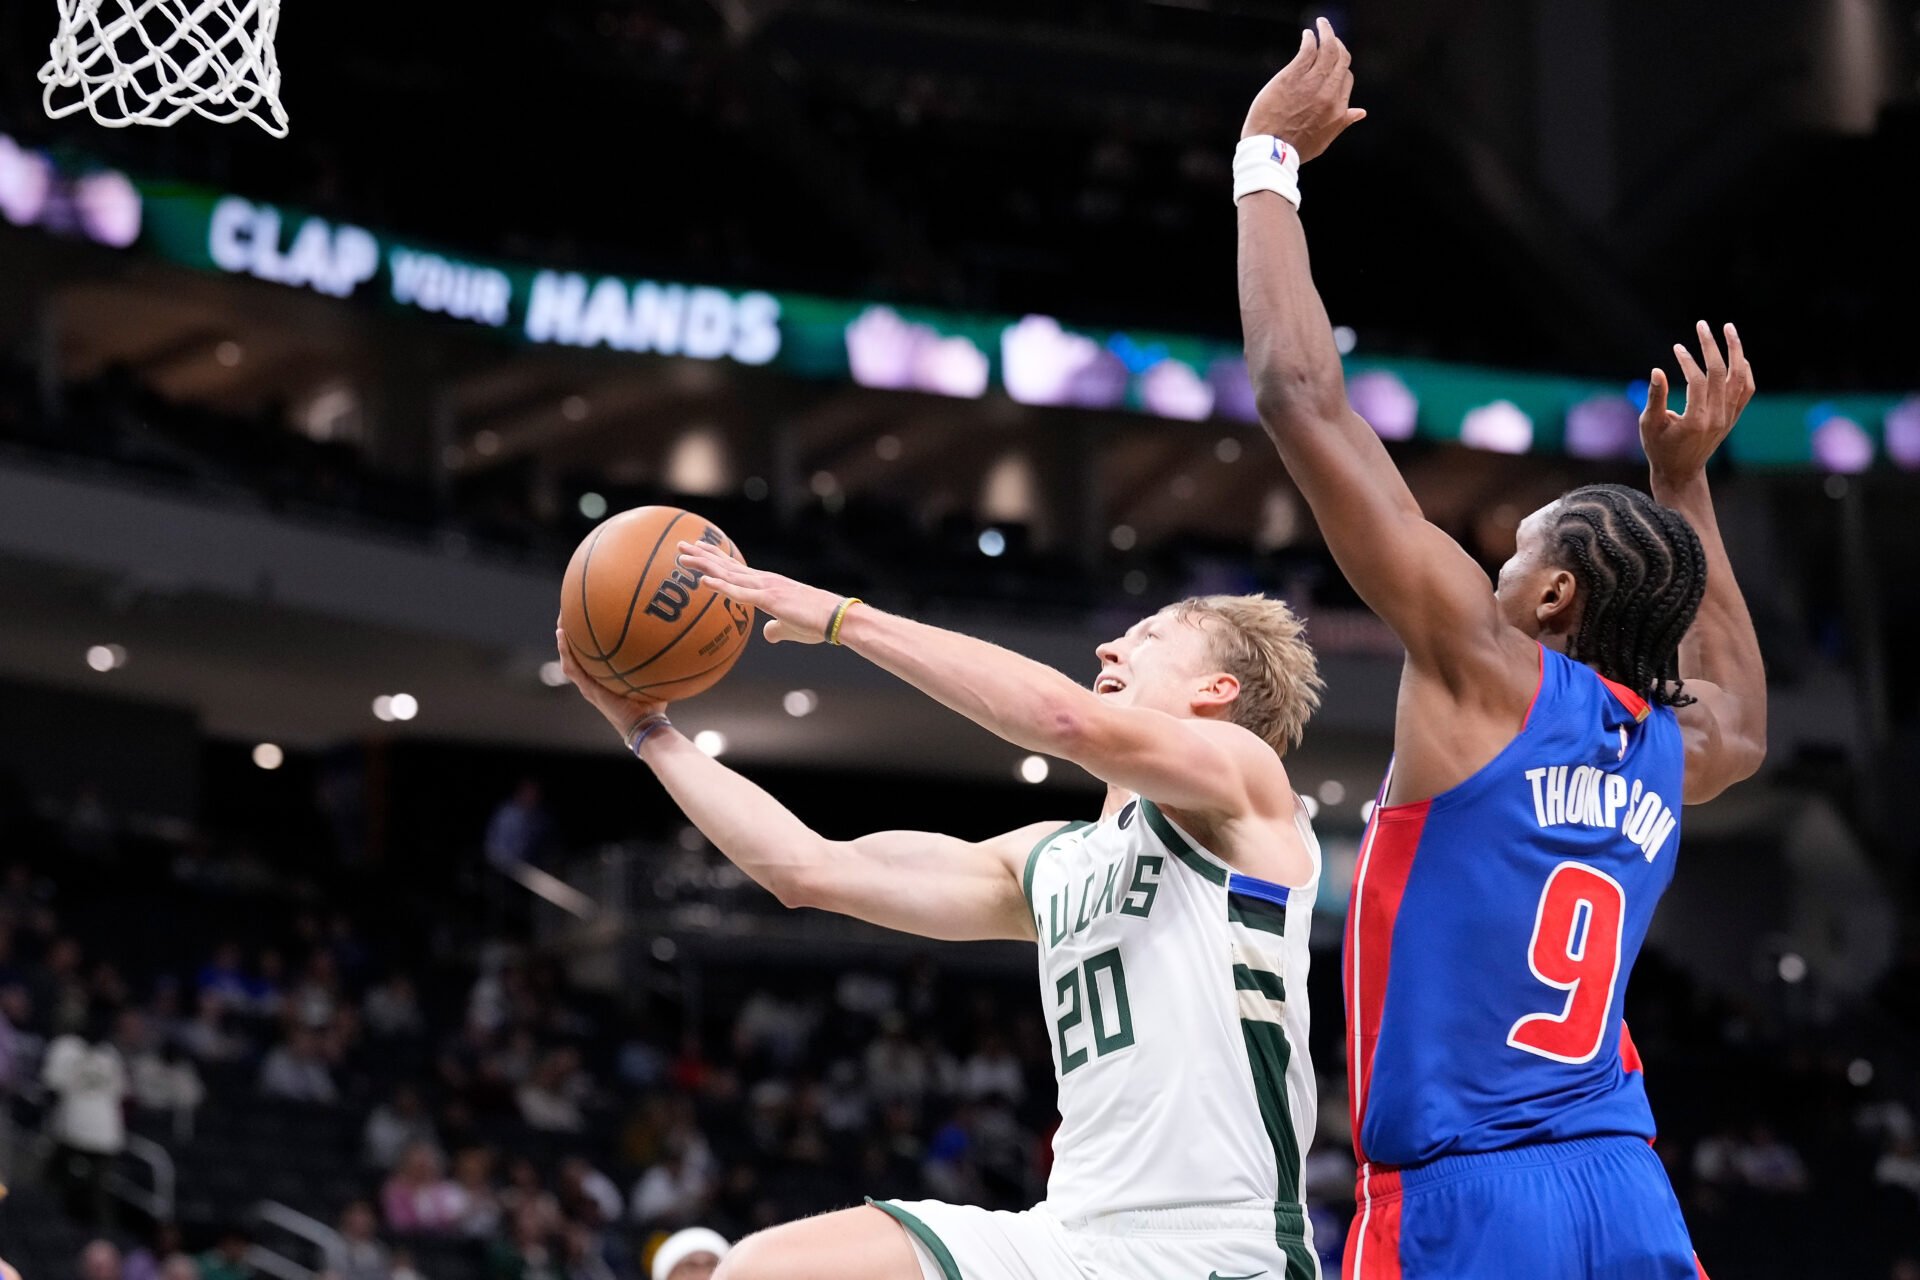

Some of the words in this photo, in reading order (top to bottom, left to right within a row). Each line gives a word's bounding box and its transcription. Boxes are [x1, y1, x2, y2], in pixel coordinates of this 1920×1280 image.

[208, 195, 379, 298] CLAP
[390, 246, 511, 326] YOUR
[525, 271, 781, 365] HANDS
[1525, 765, 1677, 863] THOMPSON
[1038, 855, 1164, 949] UCKS
[1507, 861, 1625, 1065] 9
[1056, 947, 1135, 1076] 20
